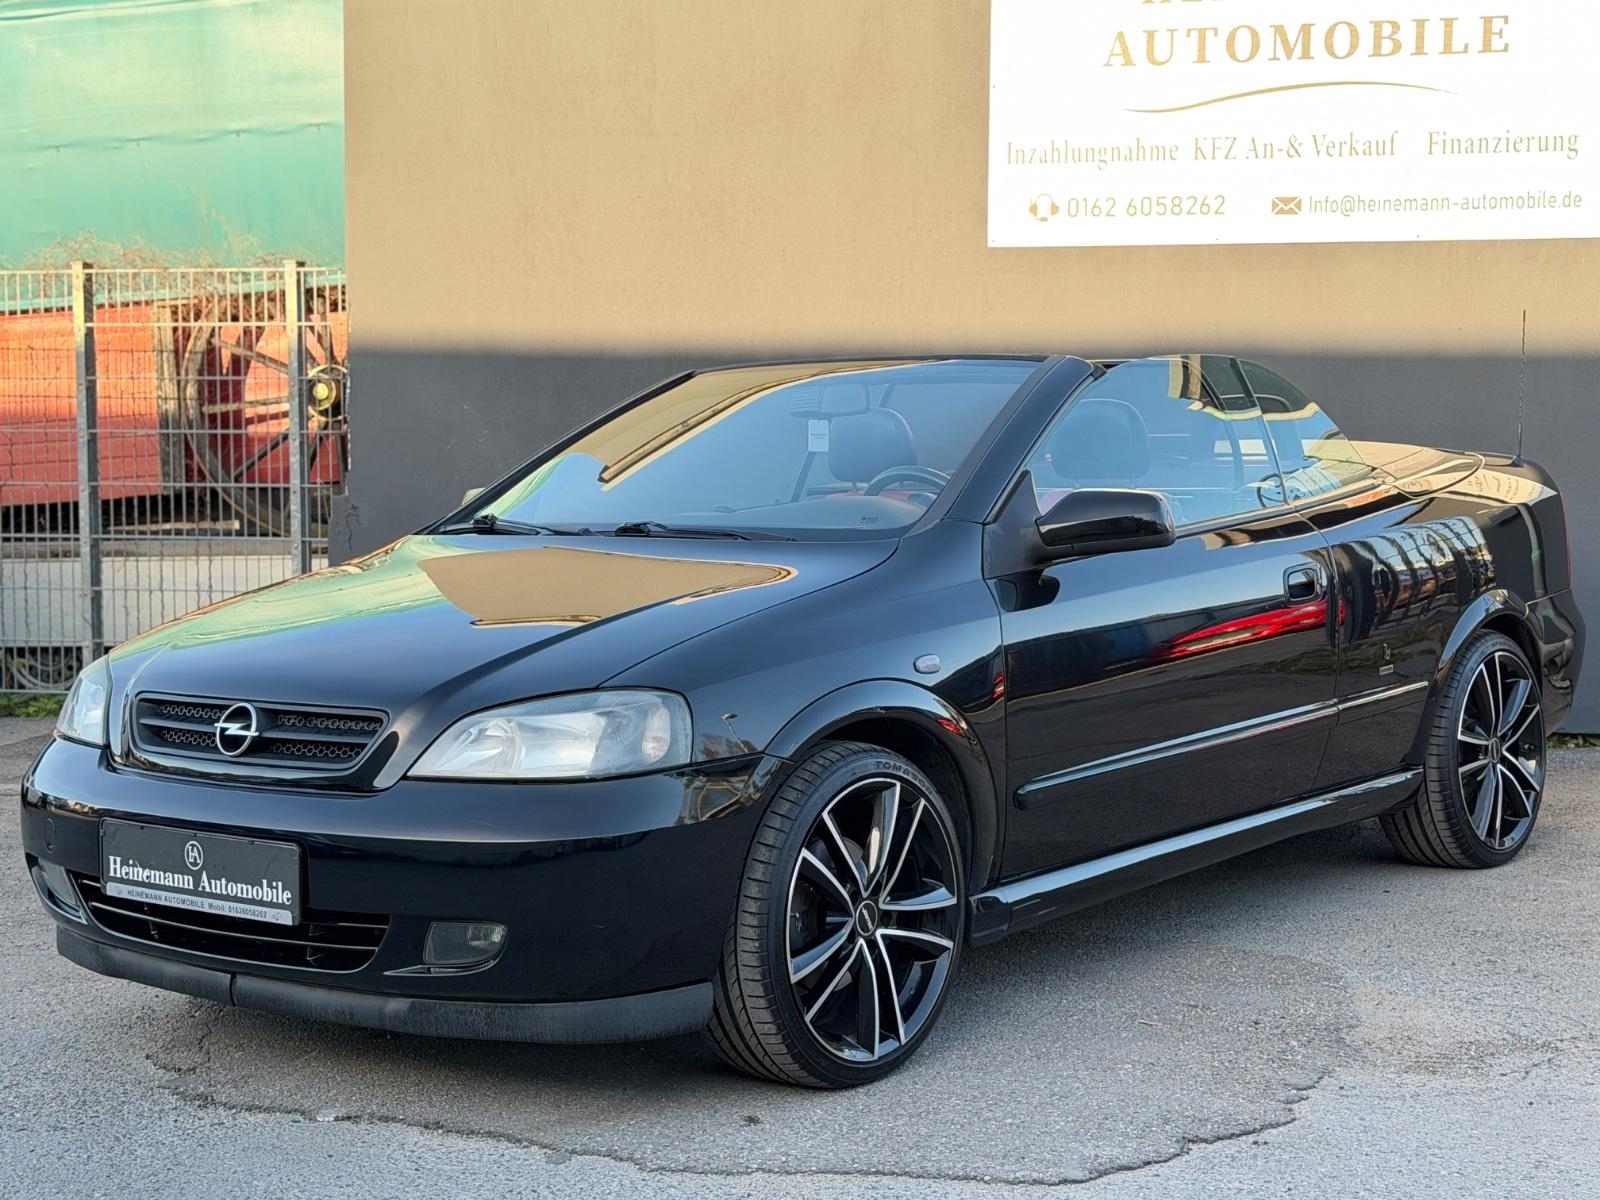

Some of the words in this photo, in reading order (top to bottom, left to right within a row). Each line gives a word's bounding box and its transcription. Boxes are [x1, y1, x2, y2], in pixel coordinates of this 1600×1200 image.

[1103, 15, 1510, 67] AUTOMOBILE
[1006, 138, 1179, 170] Inzahlungnahme
[1193, 136, 1238, 161] KFZ
[1311, 130, 1398, 158] Verkauf
[1427, 129, 1580, 160] Finanzierung
[1067, 197, 1117, 218] 0162
[1126, 194, 1226, 217] 6058262
[1308, 190, 1583, 217] Info@heinemann-automobile.de
[108, 855, 194, 890] Heinemann
[198, 870, 292, 905] Automobile
[127, 889, 162, 901] HEINEMANN
[164, 895, 205, 909] AUTOMOBILE
